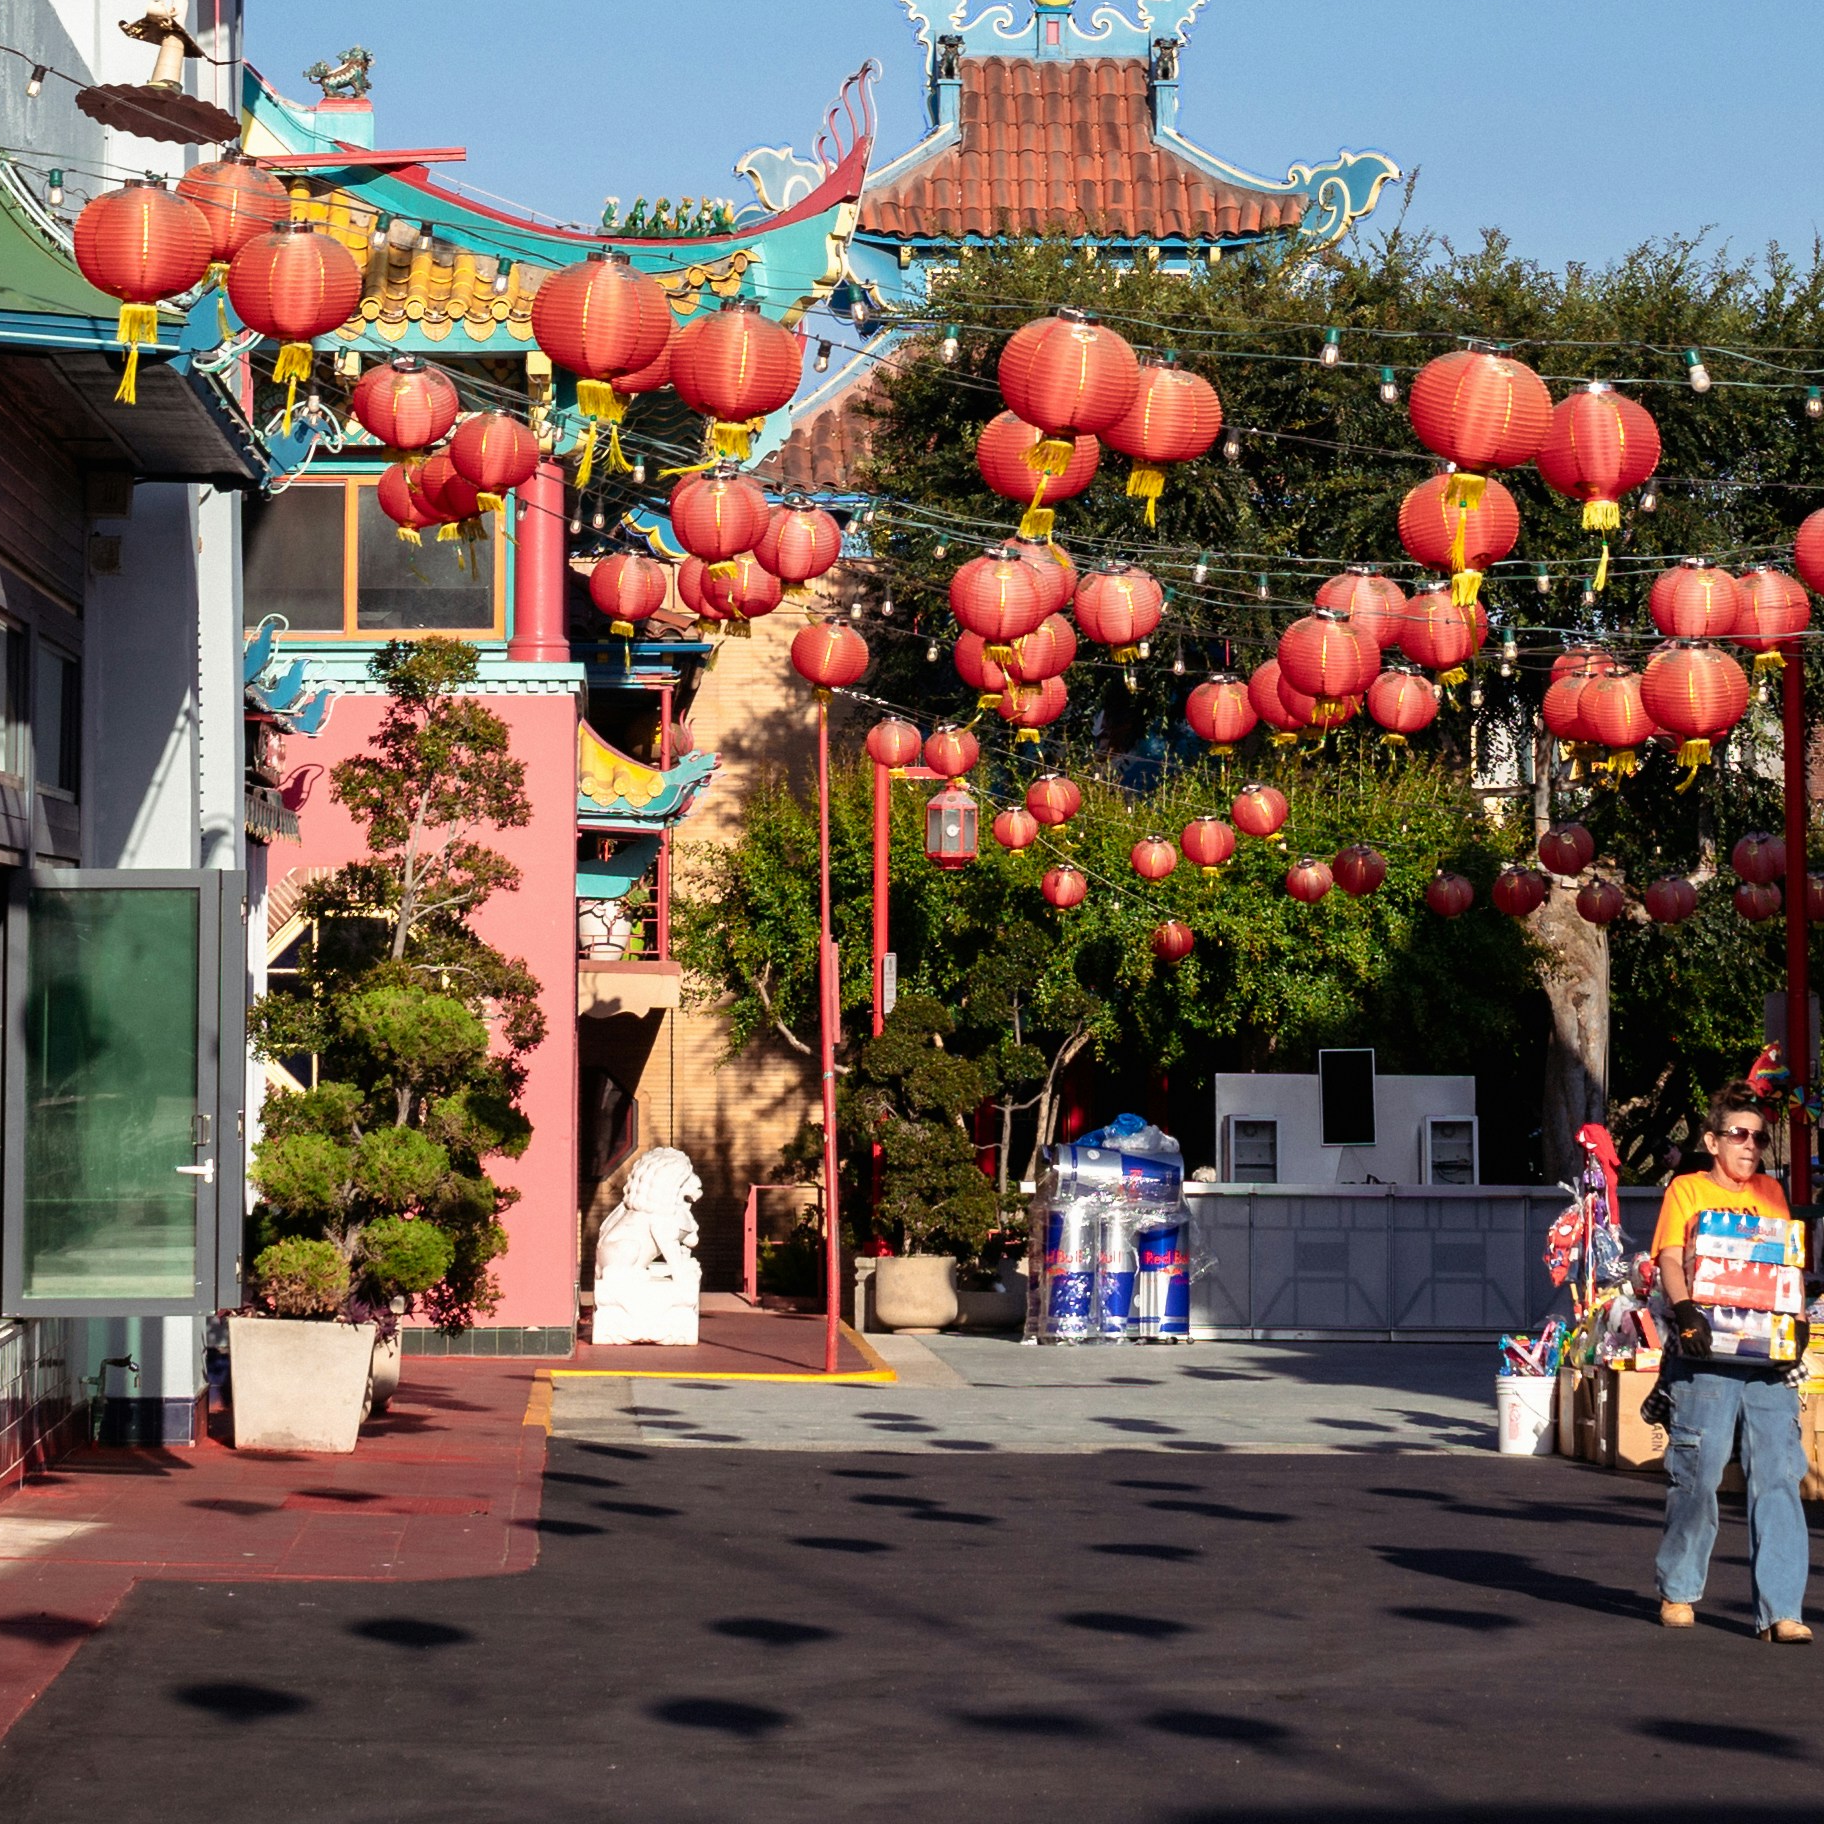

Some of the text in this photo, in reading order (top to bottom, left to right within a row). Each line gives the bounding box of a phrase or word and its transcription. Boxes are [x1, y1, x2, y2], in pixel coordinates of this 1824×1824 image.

[1736, 1224, 1777, 1237] Red Bull
[1144, 1250, 1171, 1265] Red
